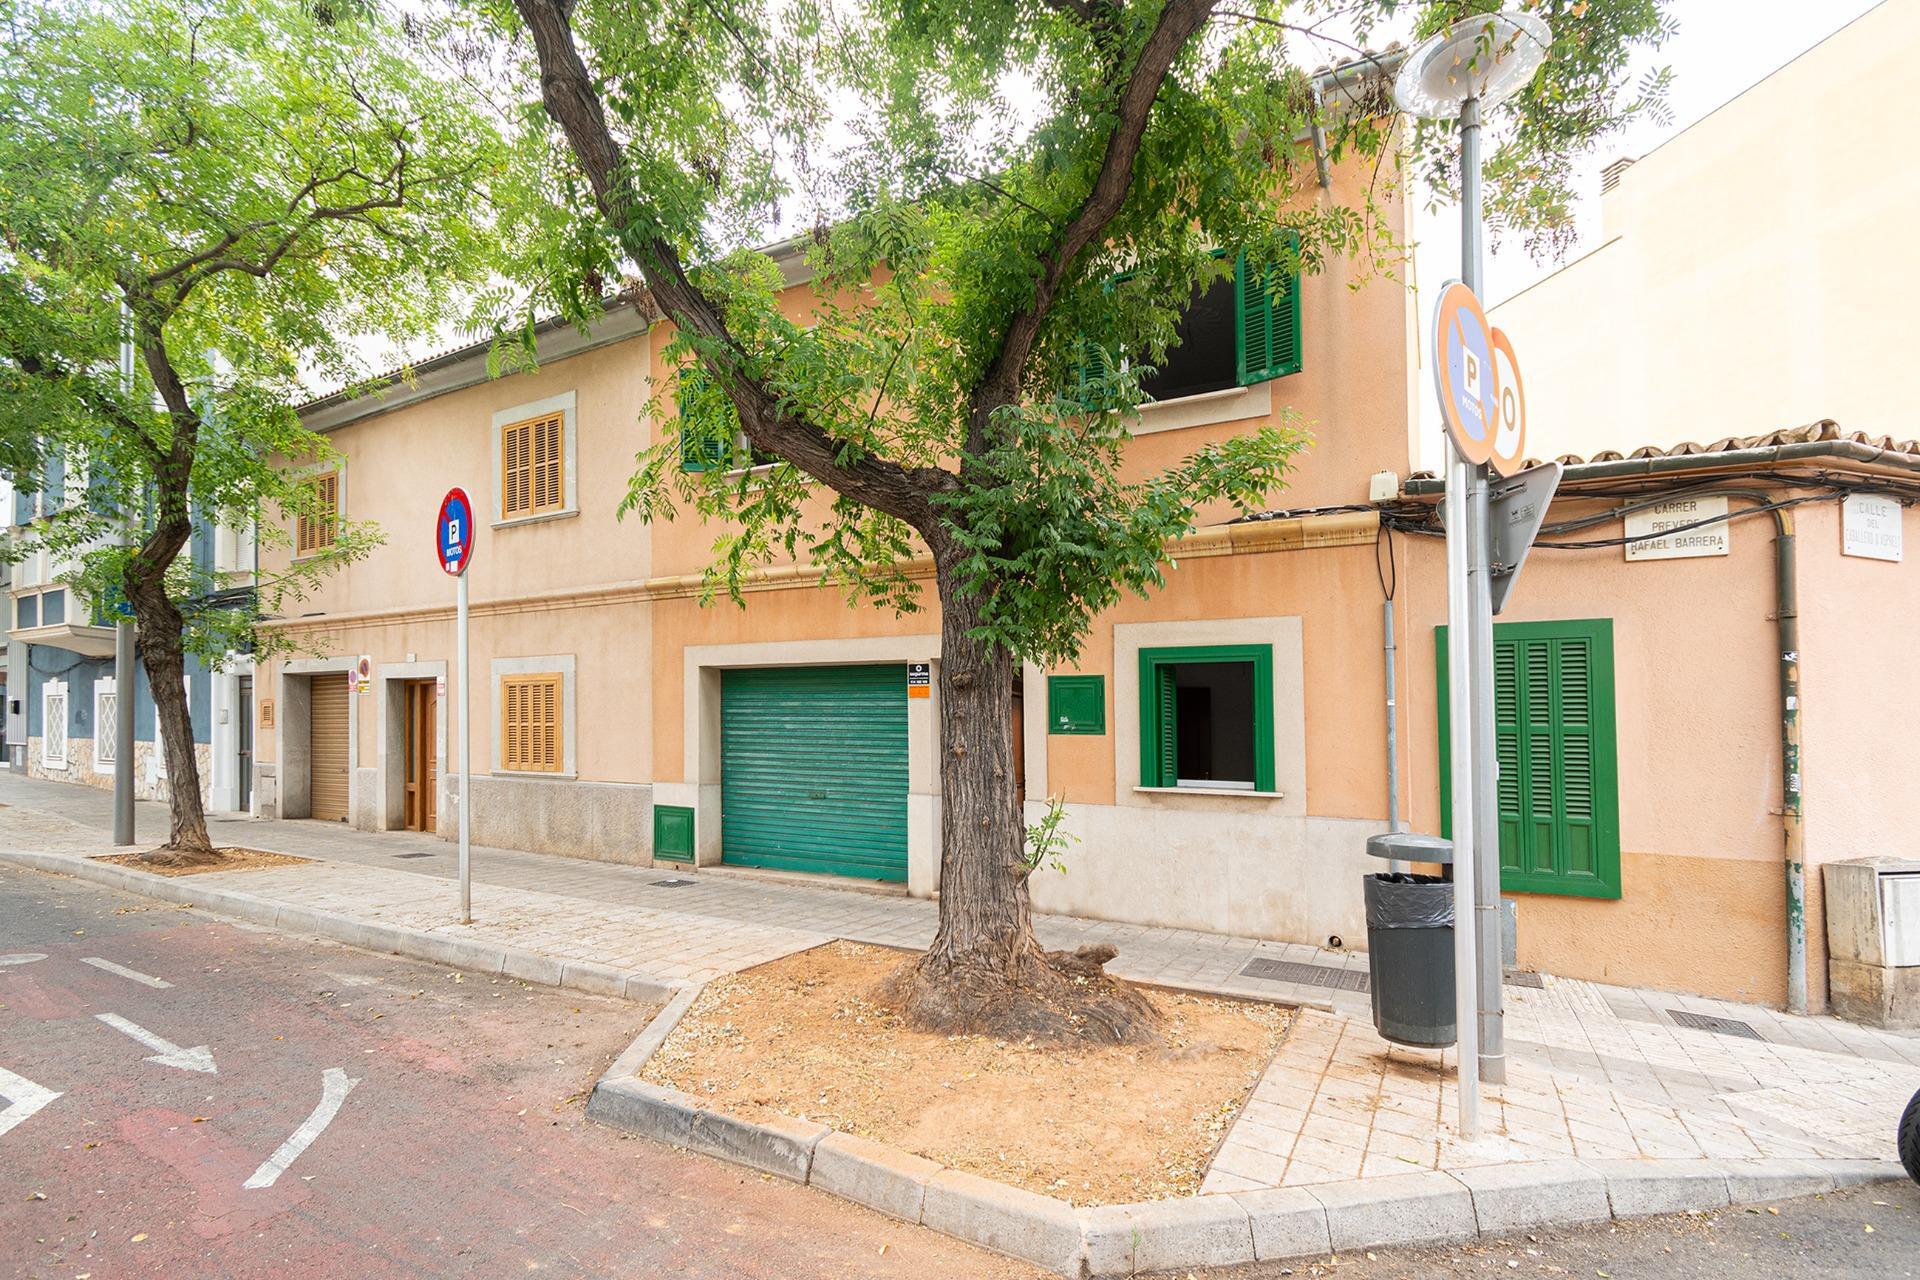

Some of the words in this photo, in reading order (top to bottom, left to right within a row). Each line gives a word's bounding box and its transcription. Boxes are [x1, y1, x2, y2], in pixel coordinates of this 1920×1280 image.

[1467, 354, 1477, 388] P
[1654, 500, 1697, 514] CARRER
[1859, 502, 1887, 518] CALLE
[451, 524, 457, 540] P
[1631, 539, 1670, 551] RAFAEL
[1675, 535, 1724, 548] BARRERA
